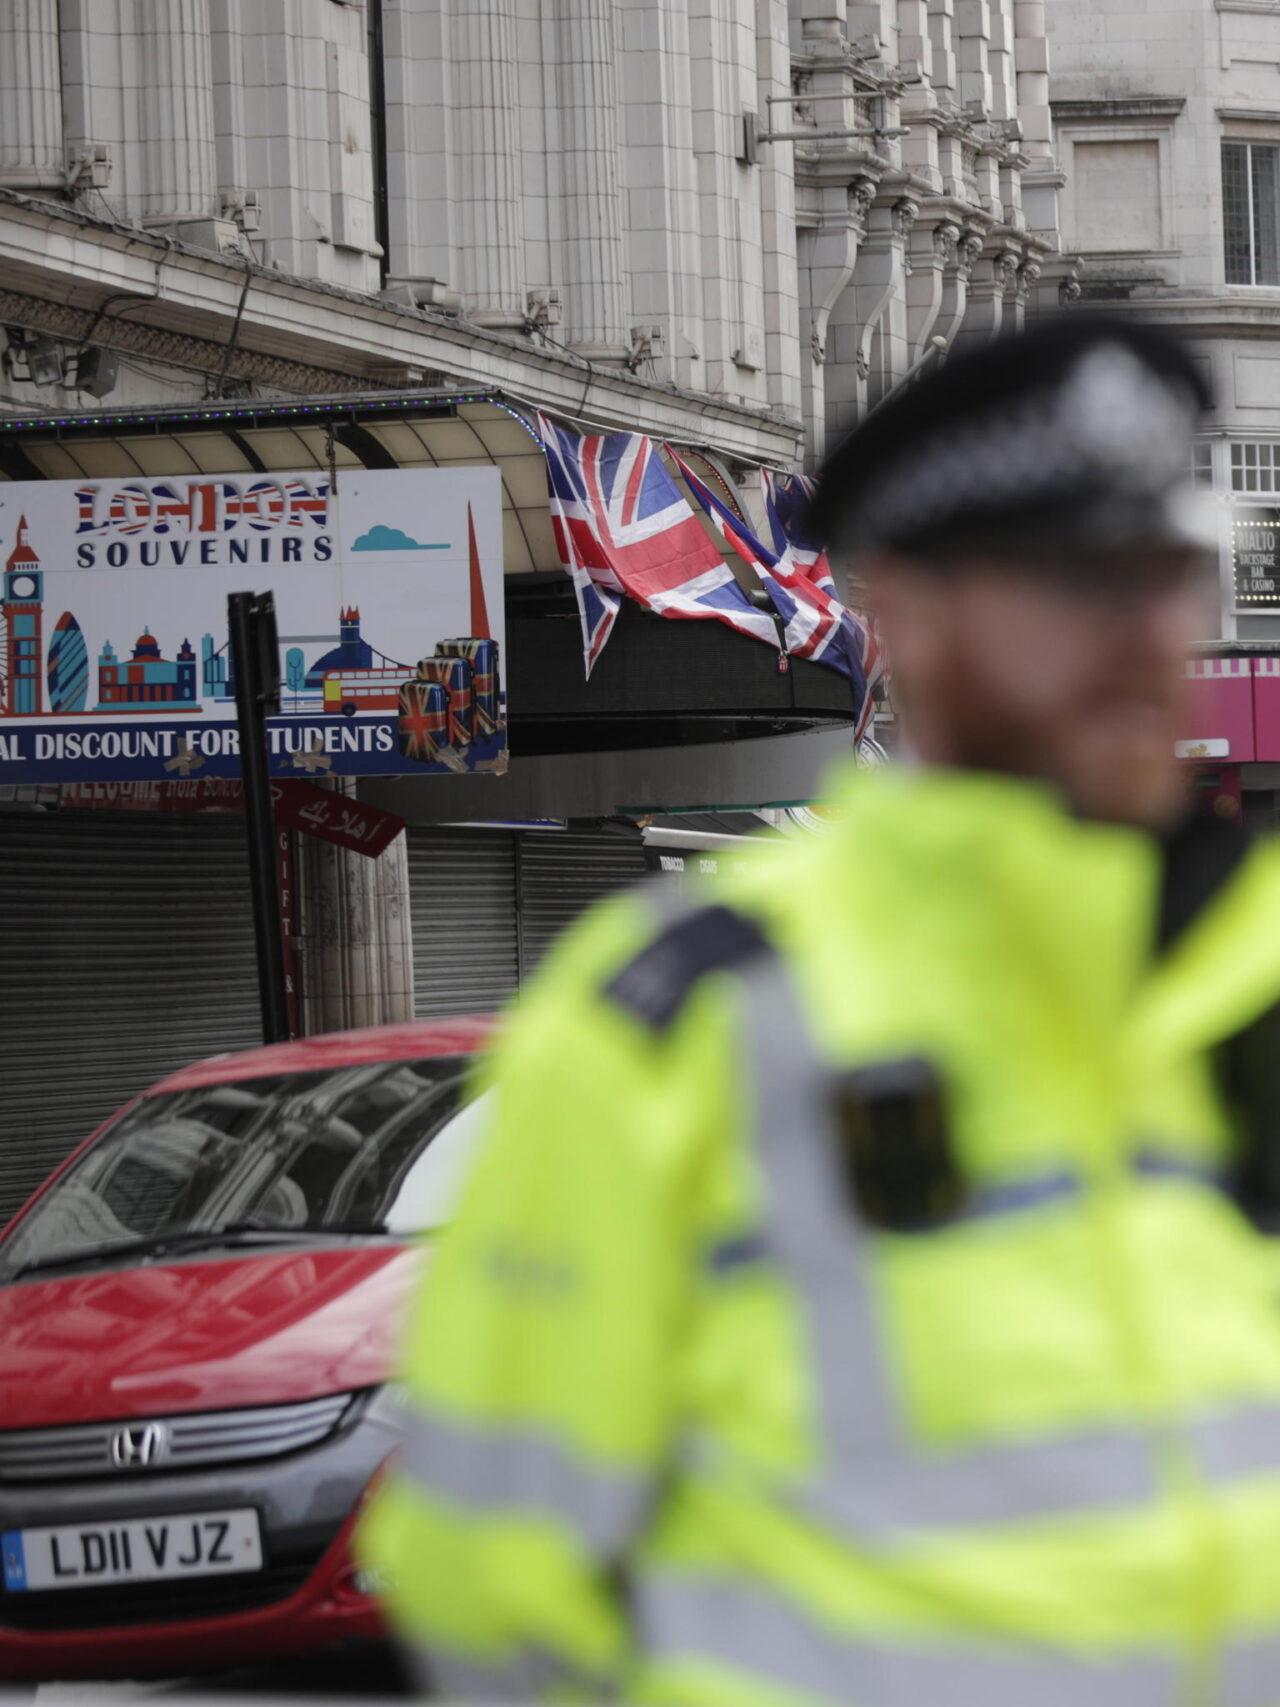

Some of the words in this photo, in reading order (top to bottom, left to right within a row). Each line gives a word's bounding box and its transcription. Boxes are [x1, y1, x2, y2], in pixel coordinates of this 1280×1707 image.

[74, 482, 330, 536] LONDON
[76, 536, 333, 569] SOUVENIRS
[1238, 531, 1275, 551] RIALTO
[35, 731, 177, 761] DISCOUNT
[185, 729, 240, 756] FOR
[266, 724, 394, 755] TUDENTS
[279, 832, 291, 936] GIFT
[146, 1520, 234, 1570] VJZ
